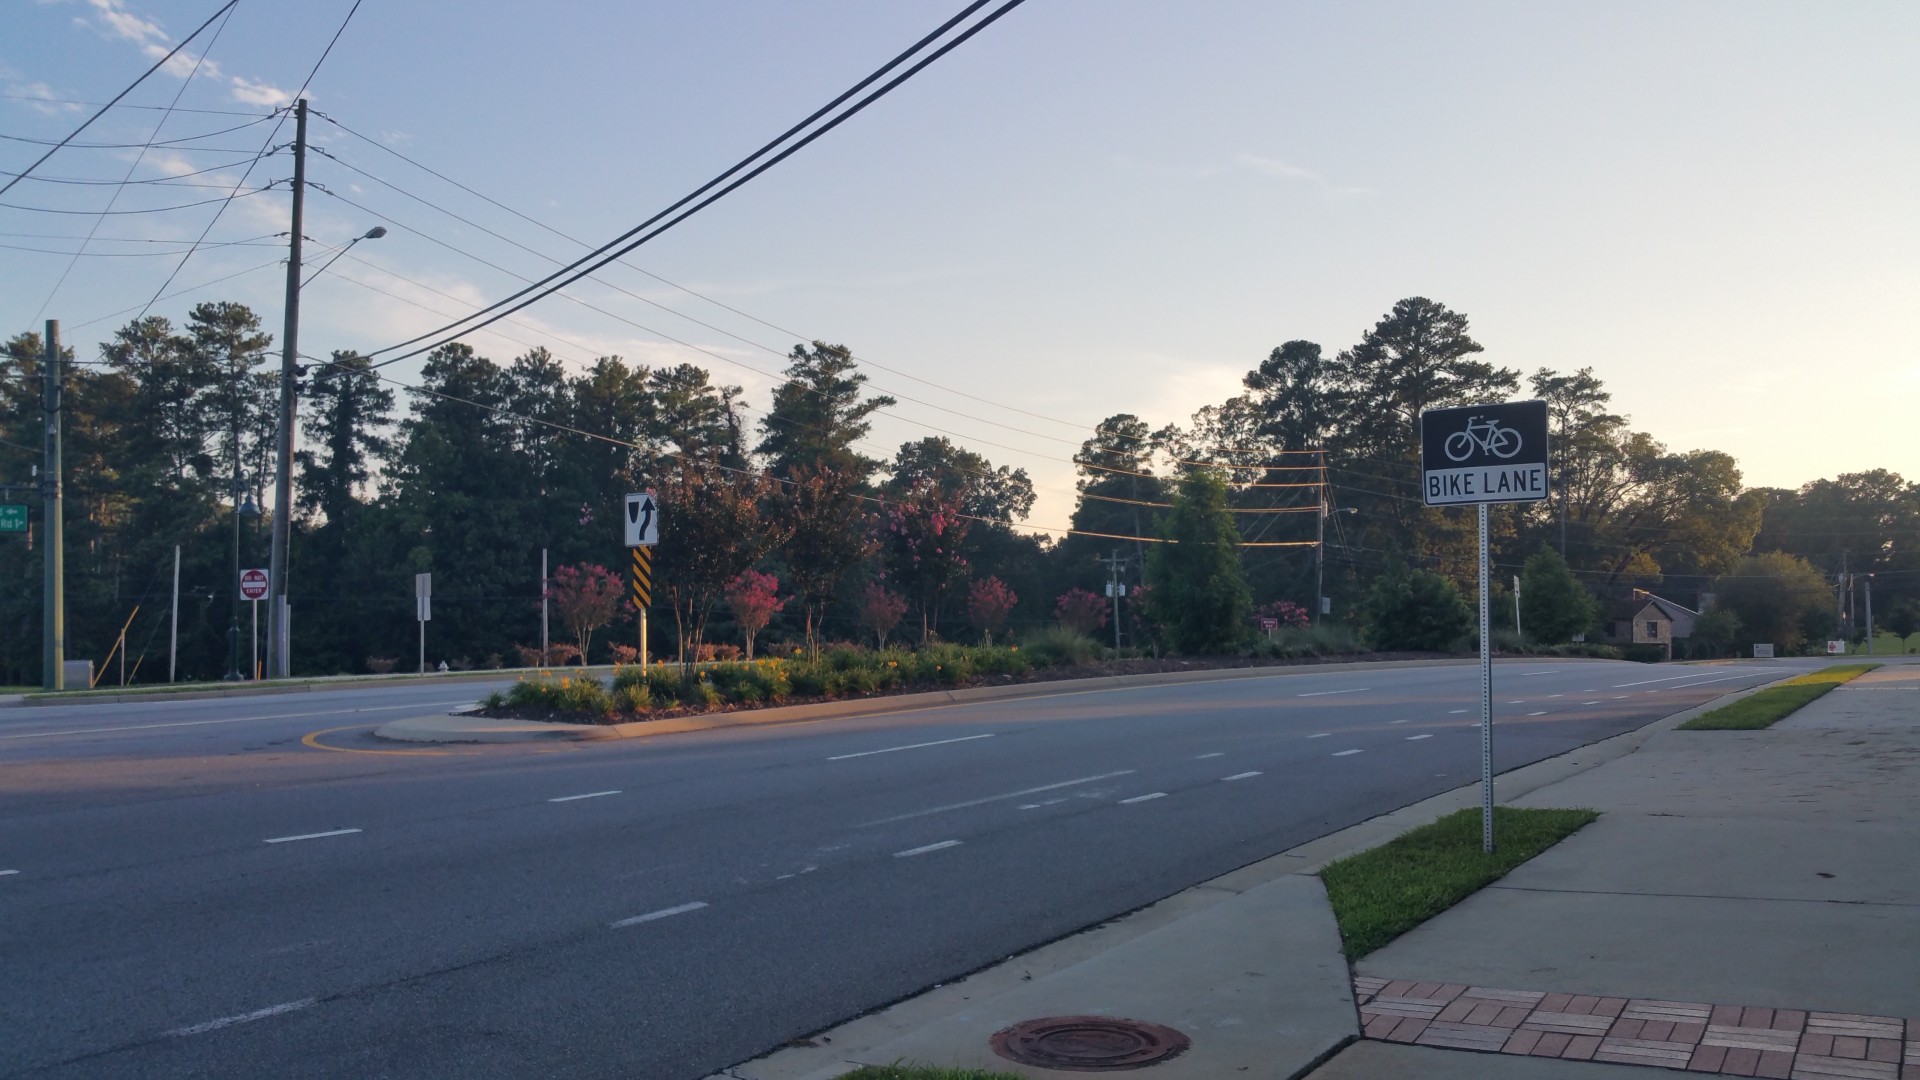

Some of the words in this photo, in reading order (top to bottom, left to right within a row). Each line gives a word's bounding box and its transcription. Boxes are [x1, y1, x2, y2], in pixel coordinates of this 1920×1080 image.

[1429, 473, 1474, 498] BIKE
[1484, 469, 1542, 494] LANE
[1, 519, 12, 528] Rd
